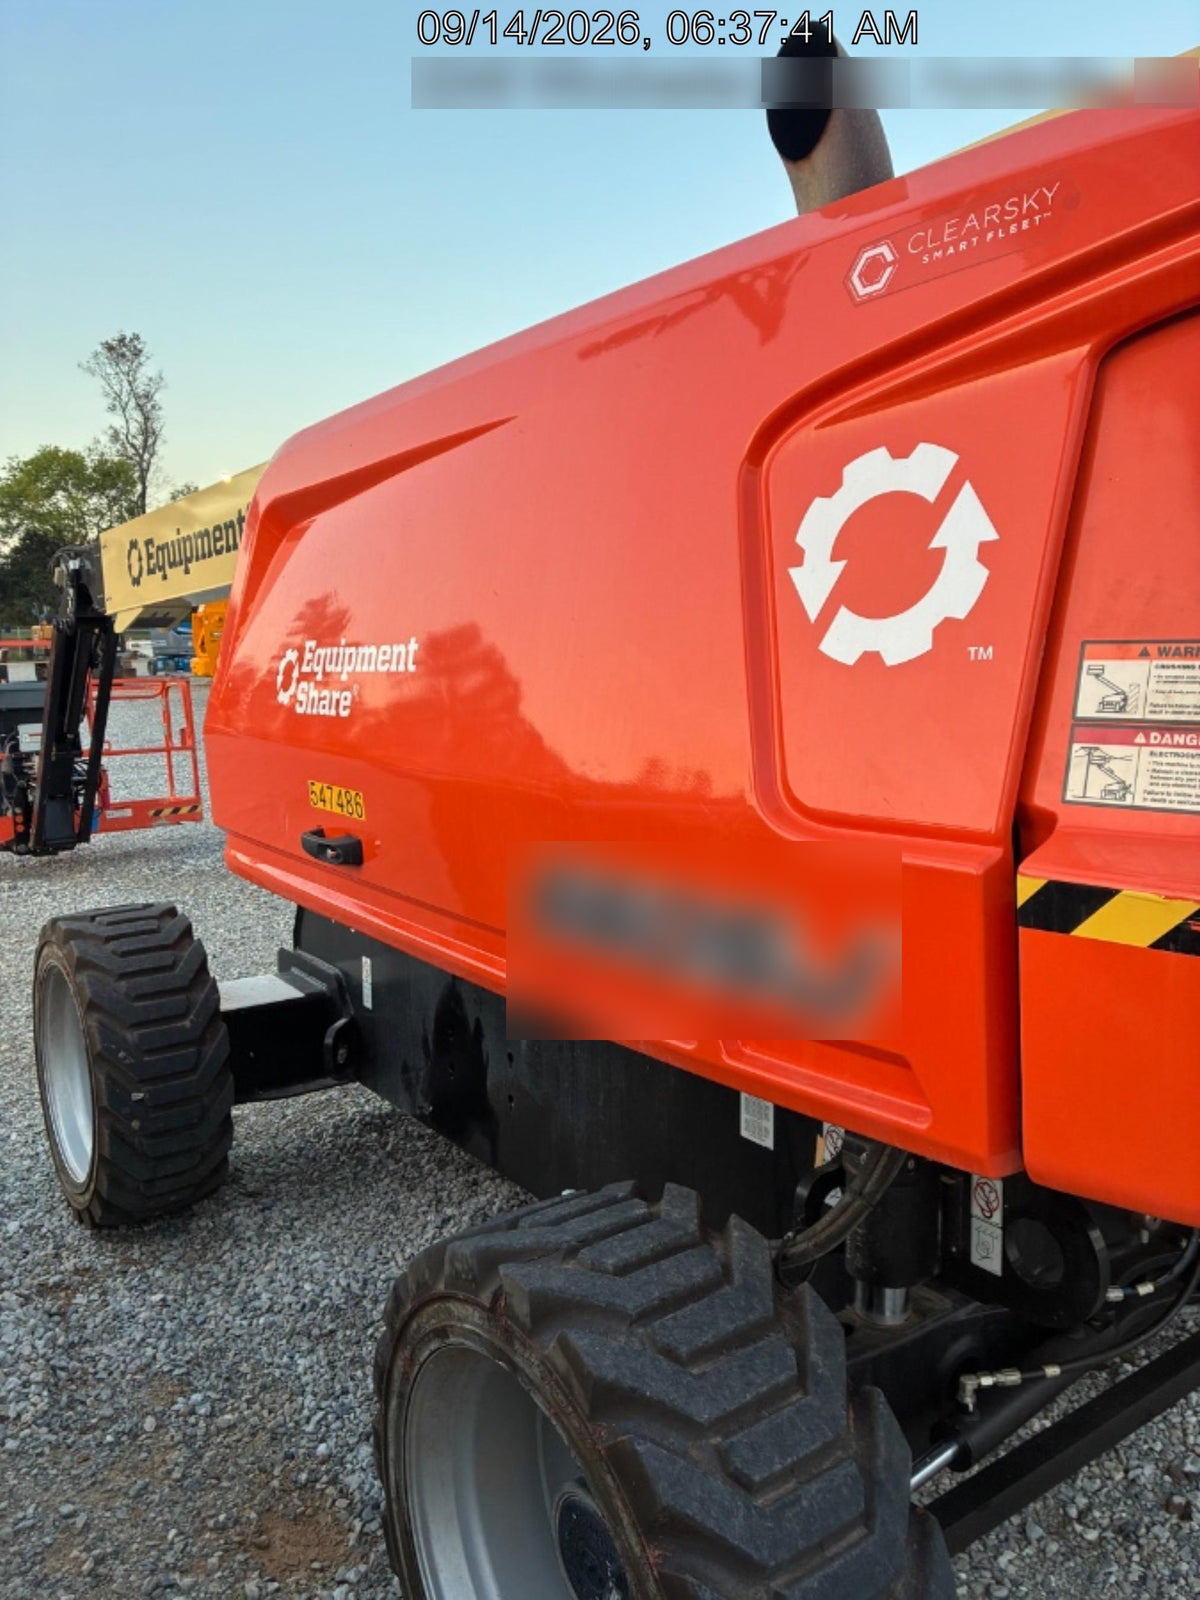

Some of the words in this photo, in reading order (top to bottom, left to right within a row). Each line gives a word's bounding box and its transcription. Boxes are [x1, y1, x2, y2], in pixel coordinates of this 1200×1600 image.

[907, 181, 1060, 253] CLEARSKY
[922, 237, 979, 264] SMART
[144, 508, 246, 581] Equipment
[301, 637, 418, 682] Equipment
[967, 645, 994, 661] TM
[1149, 731, 1200, 746] DANG
[309, 782, 364, 819] 547486
